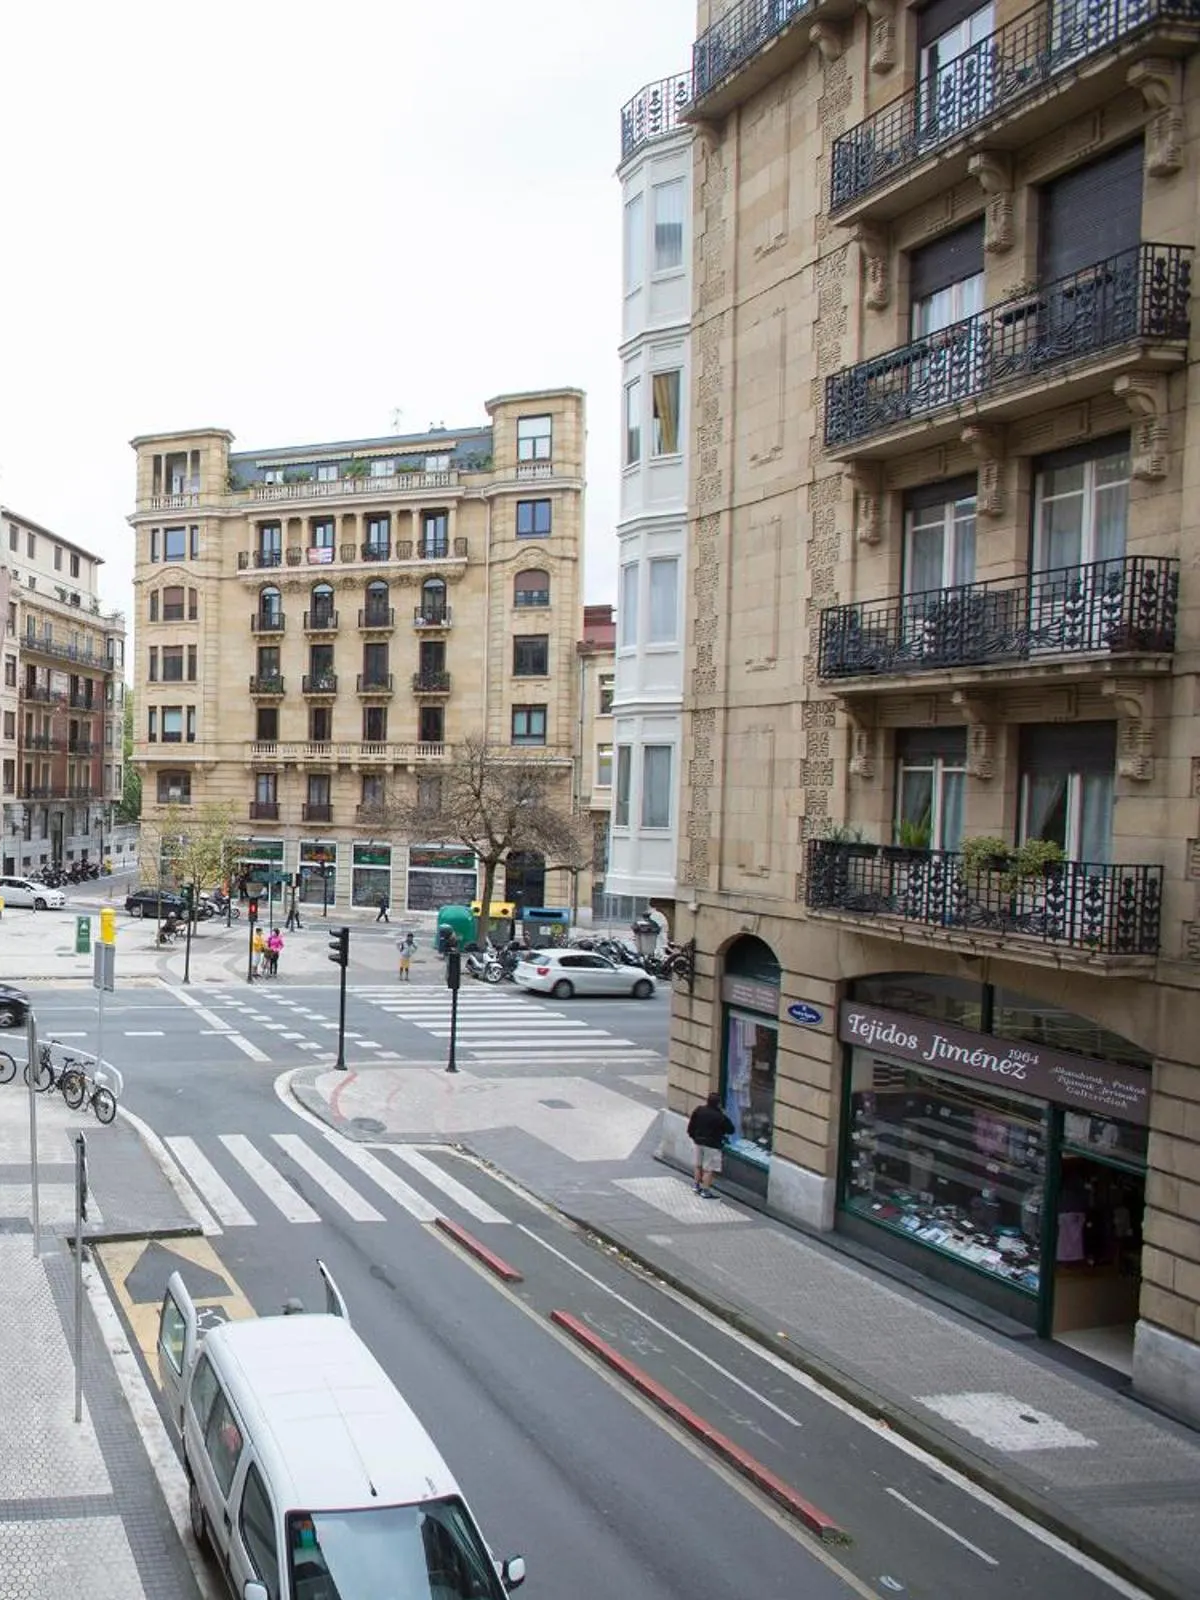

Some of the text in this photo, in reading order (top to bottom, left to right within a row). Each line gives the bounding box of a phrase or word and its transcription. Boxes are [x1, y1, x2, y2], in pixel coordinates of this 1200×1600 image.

[848, 1014, 1027, 1080] Tejidos Jiménez
[1008, 1049, 1040, 1065] 1964
